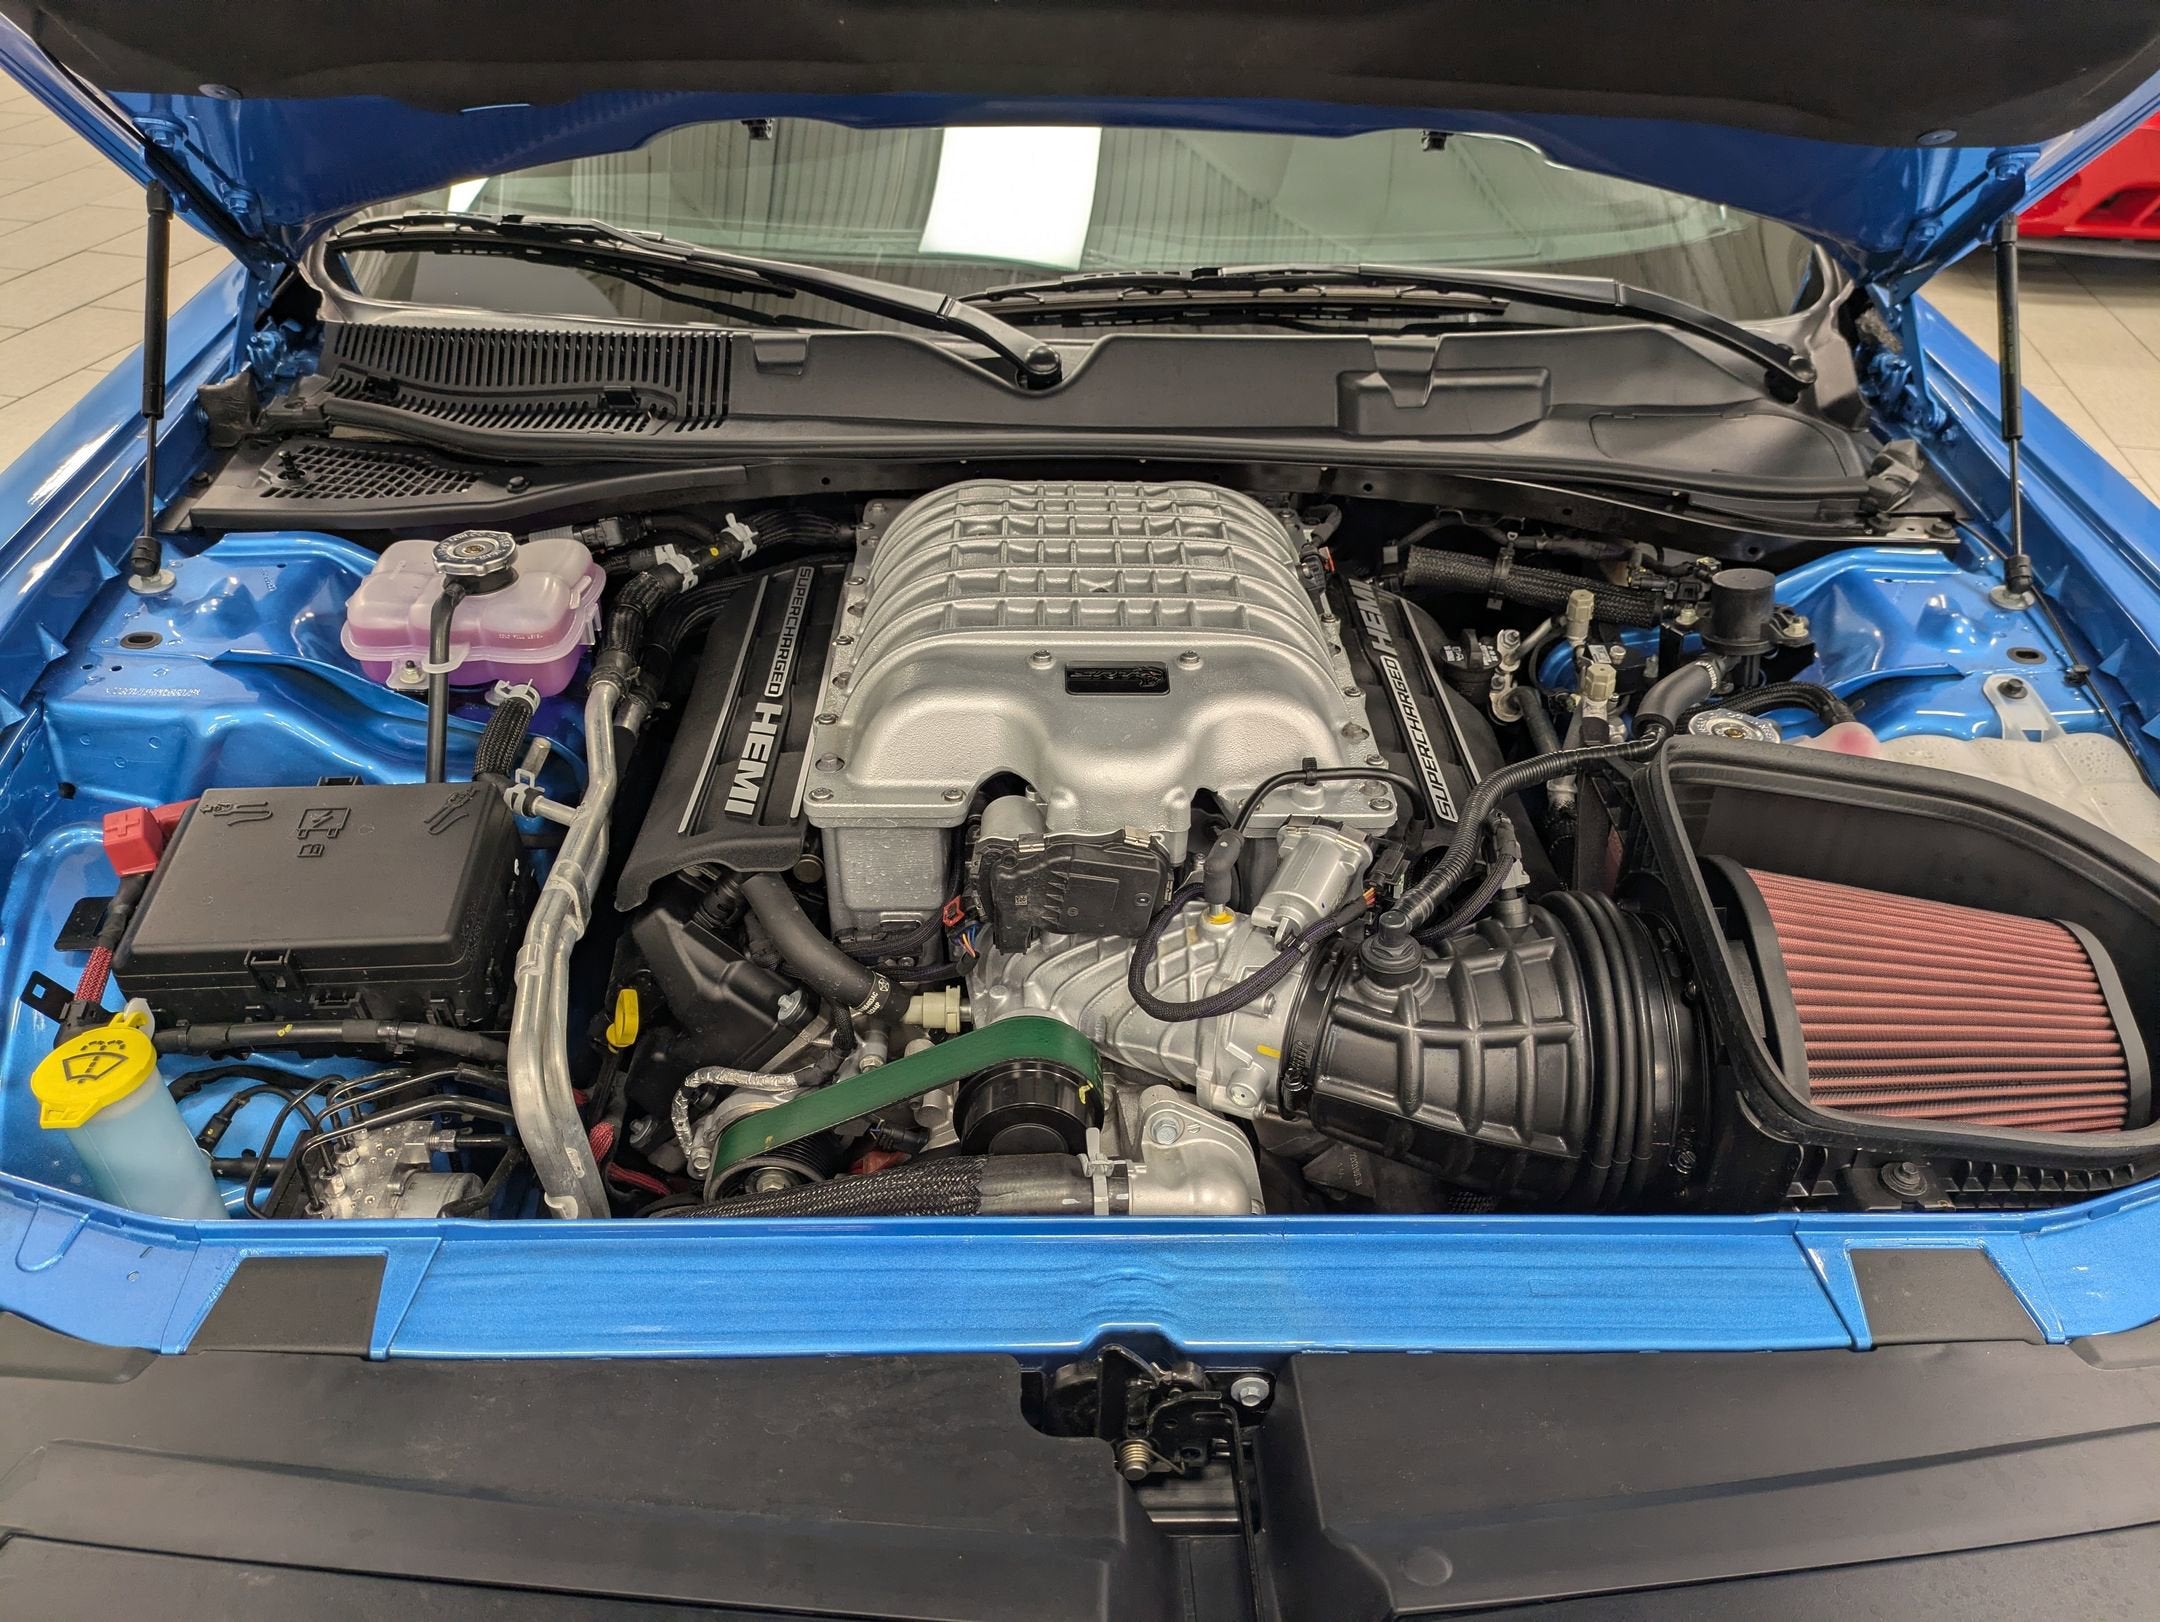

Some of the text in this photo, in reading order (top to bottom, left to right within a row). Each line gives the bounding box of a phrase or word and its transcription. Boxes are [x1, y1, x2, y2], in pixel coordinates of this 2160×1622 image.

[724, 567, 812, 816] SUPERCHARGED HEMI
[1348, 578, 1457, 821] SUPERCHARGED HEMI
